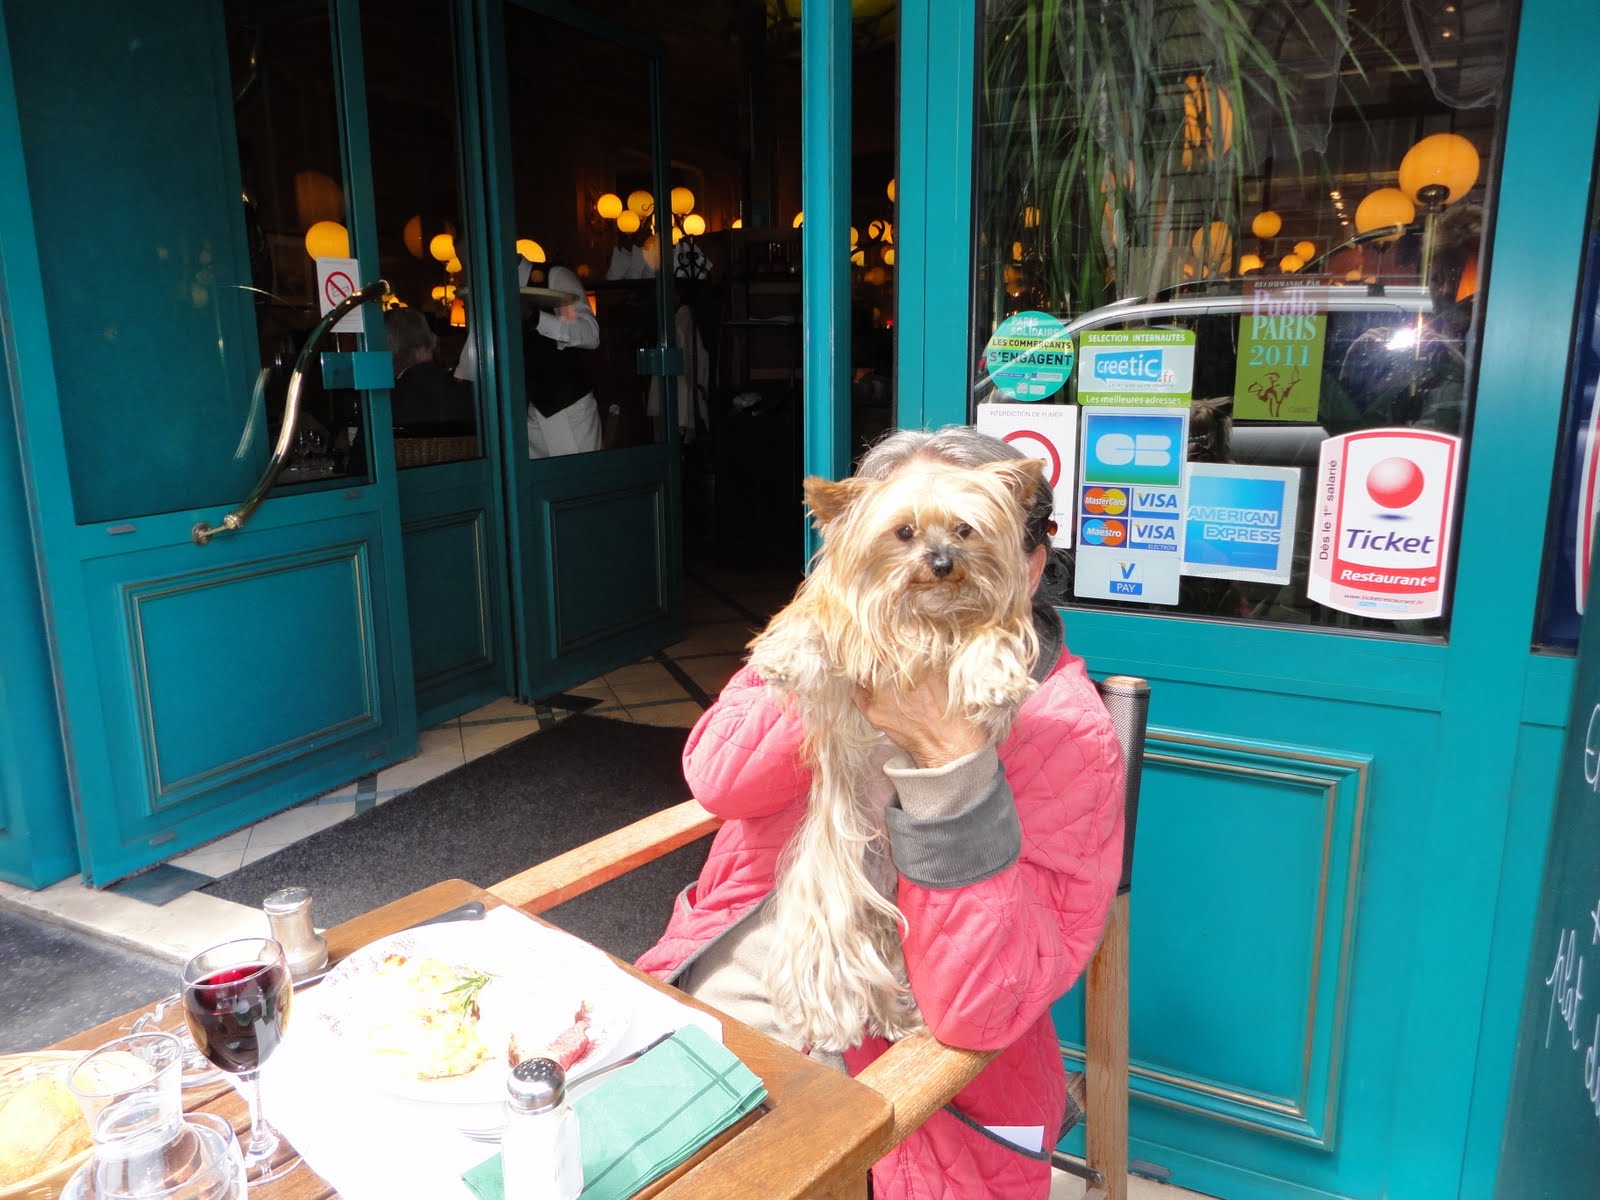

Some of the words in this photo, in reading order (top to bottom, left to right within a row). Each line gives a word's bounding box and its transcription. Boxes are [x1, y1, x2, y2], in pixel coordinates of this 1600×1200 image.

[1010, 316, 1039, 327] PARIS
[1250, 314, 1318, 341] PARIS
[992, 339, 1007, 347] LES
[1009, 339, 1072, 350] COMMERÇANTS
[1088, 334, 1129, 343] SELECTION
[1132, 333, 1186, 343] INTERNAUTES
[989, 351, 1073, 366] S'ENGAGENT
[1248, 344, 1312, 367] 2011
[1086, 396, 1099, 404] Les
[1101, 395, 1142, 404] meilleures
[1145, 396, 1181, 405] adresses
[990, 410, 1031, 418] INTERDICTION
[1095, 433, 1172, 467] CB
[1326, 460, 1338, 502] salarié
[1084, 495, 1126, 507] MasterCard
[1136, 492, 1178, 508] VISA
[1187, 506, 1277, 526] AMERICAN
[1086, 526, 1122, 537] Maestro
[1134, 524, 1176, 540] VISA
[1204, 524, 1281, 545] EXPRESS
[1322, 521, 1332, 533] le
[1147, 544, 1176, 552] ELECTRON
[1319, 536, 1331, 561] Dès
[1346, 528, 1434, 554] Ticket
[1117, 561, 1136, 579] V
[1116, 583, 1136, 593] PAY
[1344, 593, 1425, 606] www.ticketrestaurant.fr
